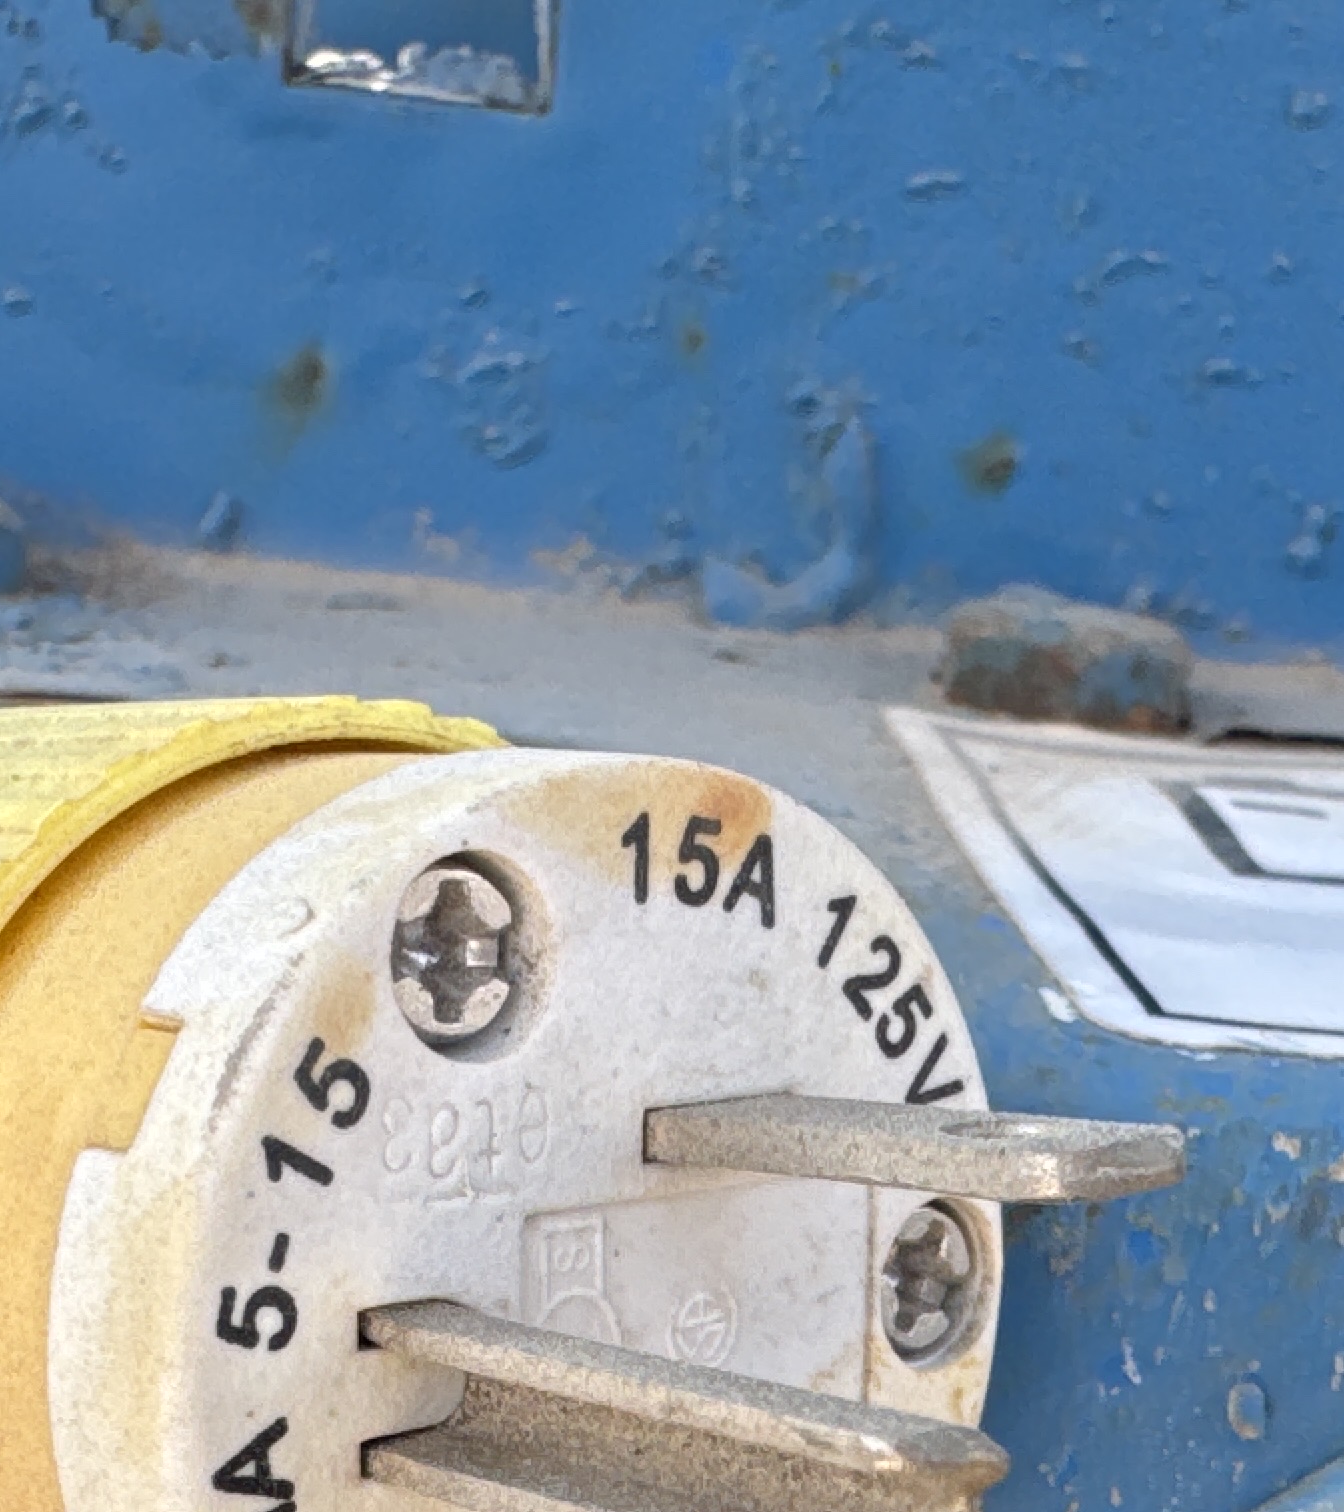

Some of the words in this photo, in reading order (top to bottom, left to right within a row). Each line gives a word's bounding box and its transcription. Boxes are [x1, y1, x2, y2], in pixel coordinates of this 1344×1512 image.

[621, 812, 776, 930] 15A
[816, 894, 964, 1105] 125V
[216, 1037, 370, 1352] 5-15
